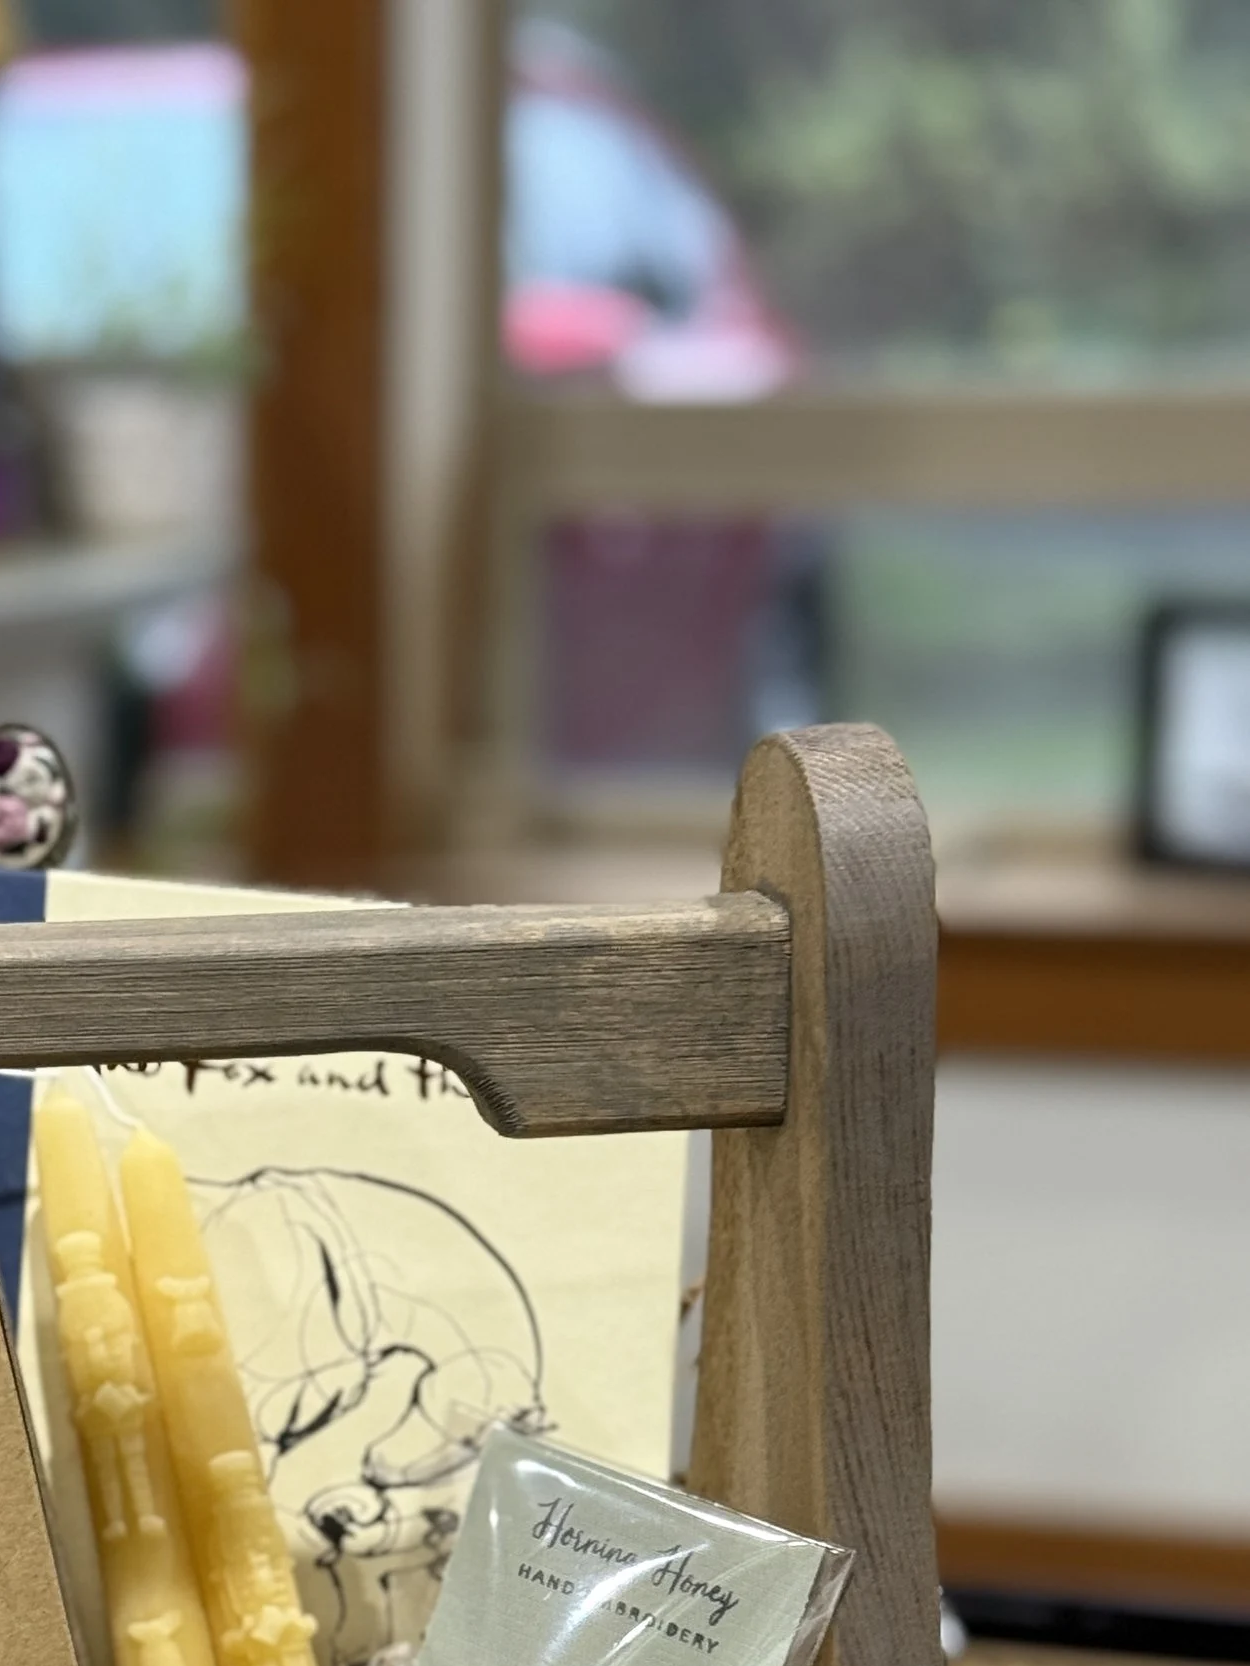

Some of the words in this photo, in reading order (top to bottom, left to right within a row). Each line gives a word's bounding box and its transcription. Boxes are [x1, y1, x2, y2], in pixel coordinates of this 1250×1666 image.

[296, 1057, 391, 1097] and
[405, 1057, 472, 1100] th
[517, 1562, 576, 1596] HAND
[583, 1584, 720, 1654] BROIDERY
[652, 1544, 739, 1626] Honey
